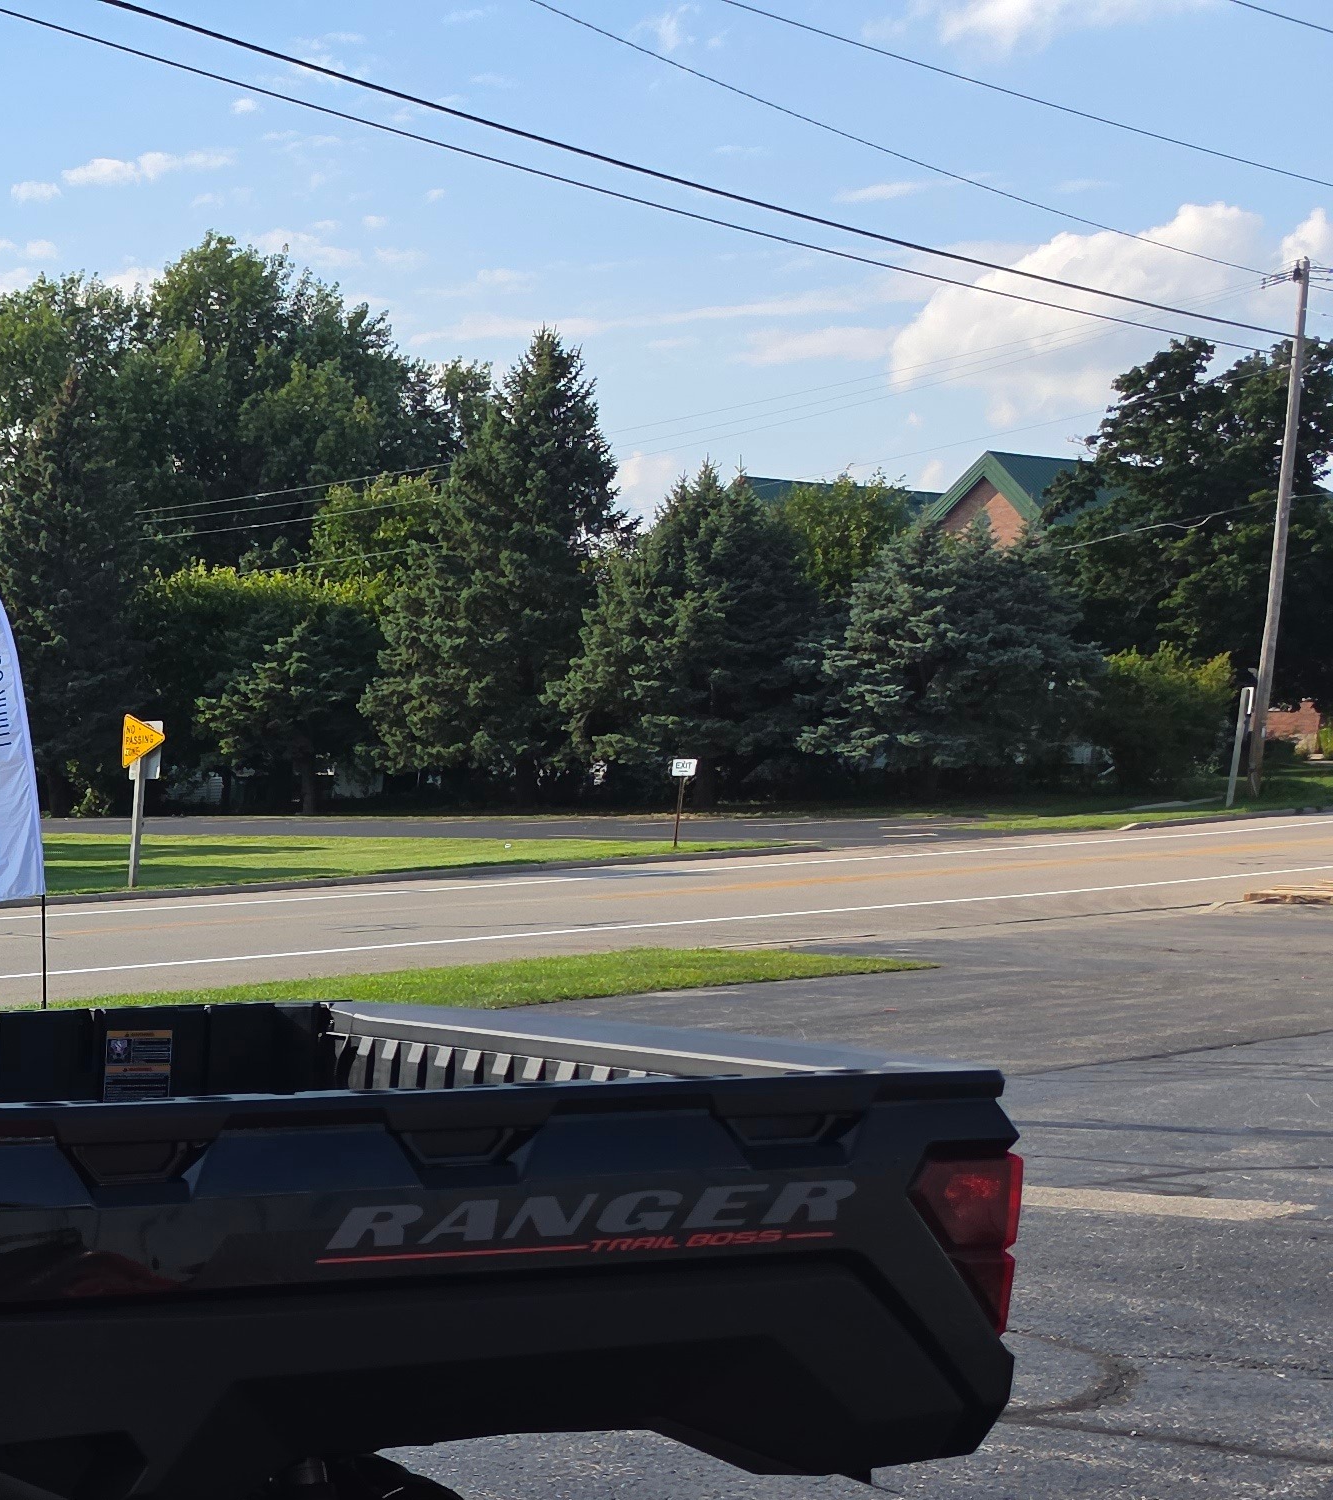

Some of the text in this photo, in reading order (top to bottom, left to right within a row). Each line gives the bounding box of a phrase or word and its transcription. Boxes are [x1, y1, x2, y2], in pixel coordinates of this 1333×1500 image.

[126, 725, 135, 734] NO
[125, 735, 153, 745] PASSING
[675, 761, 692, 769] EXIT
[325, 1179, 857, 1251] RANGER
[590, 1229, 783, 1253] TRAIL BOSS
